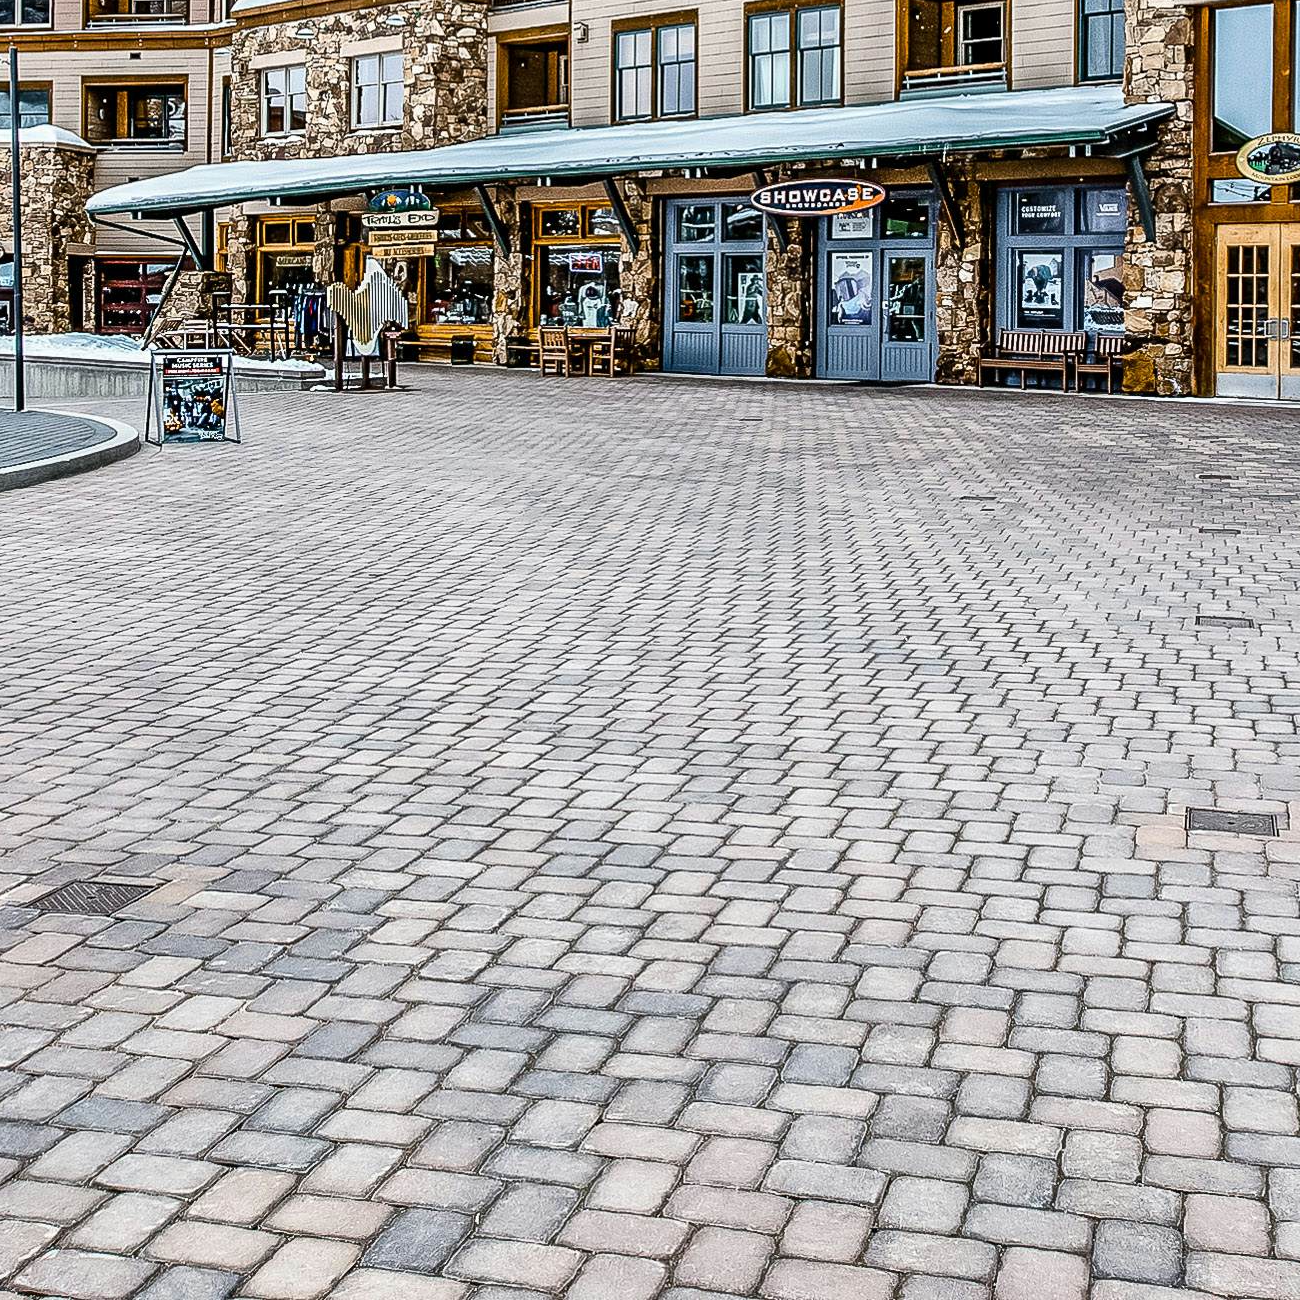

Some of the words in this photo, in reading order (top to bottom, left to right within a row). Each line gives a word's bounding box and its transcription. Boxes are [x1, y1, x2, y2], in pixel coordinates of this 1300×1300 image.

[1258, 134, 1300, 145] ZEPHYR
[760, 187, 874, 204] SHOWCASE
[785, 201, 847, 209] SNOWBOARDS
